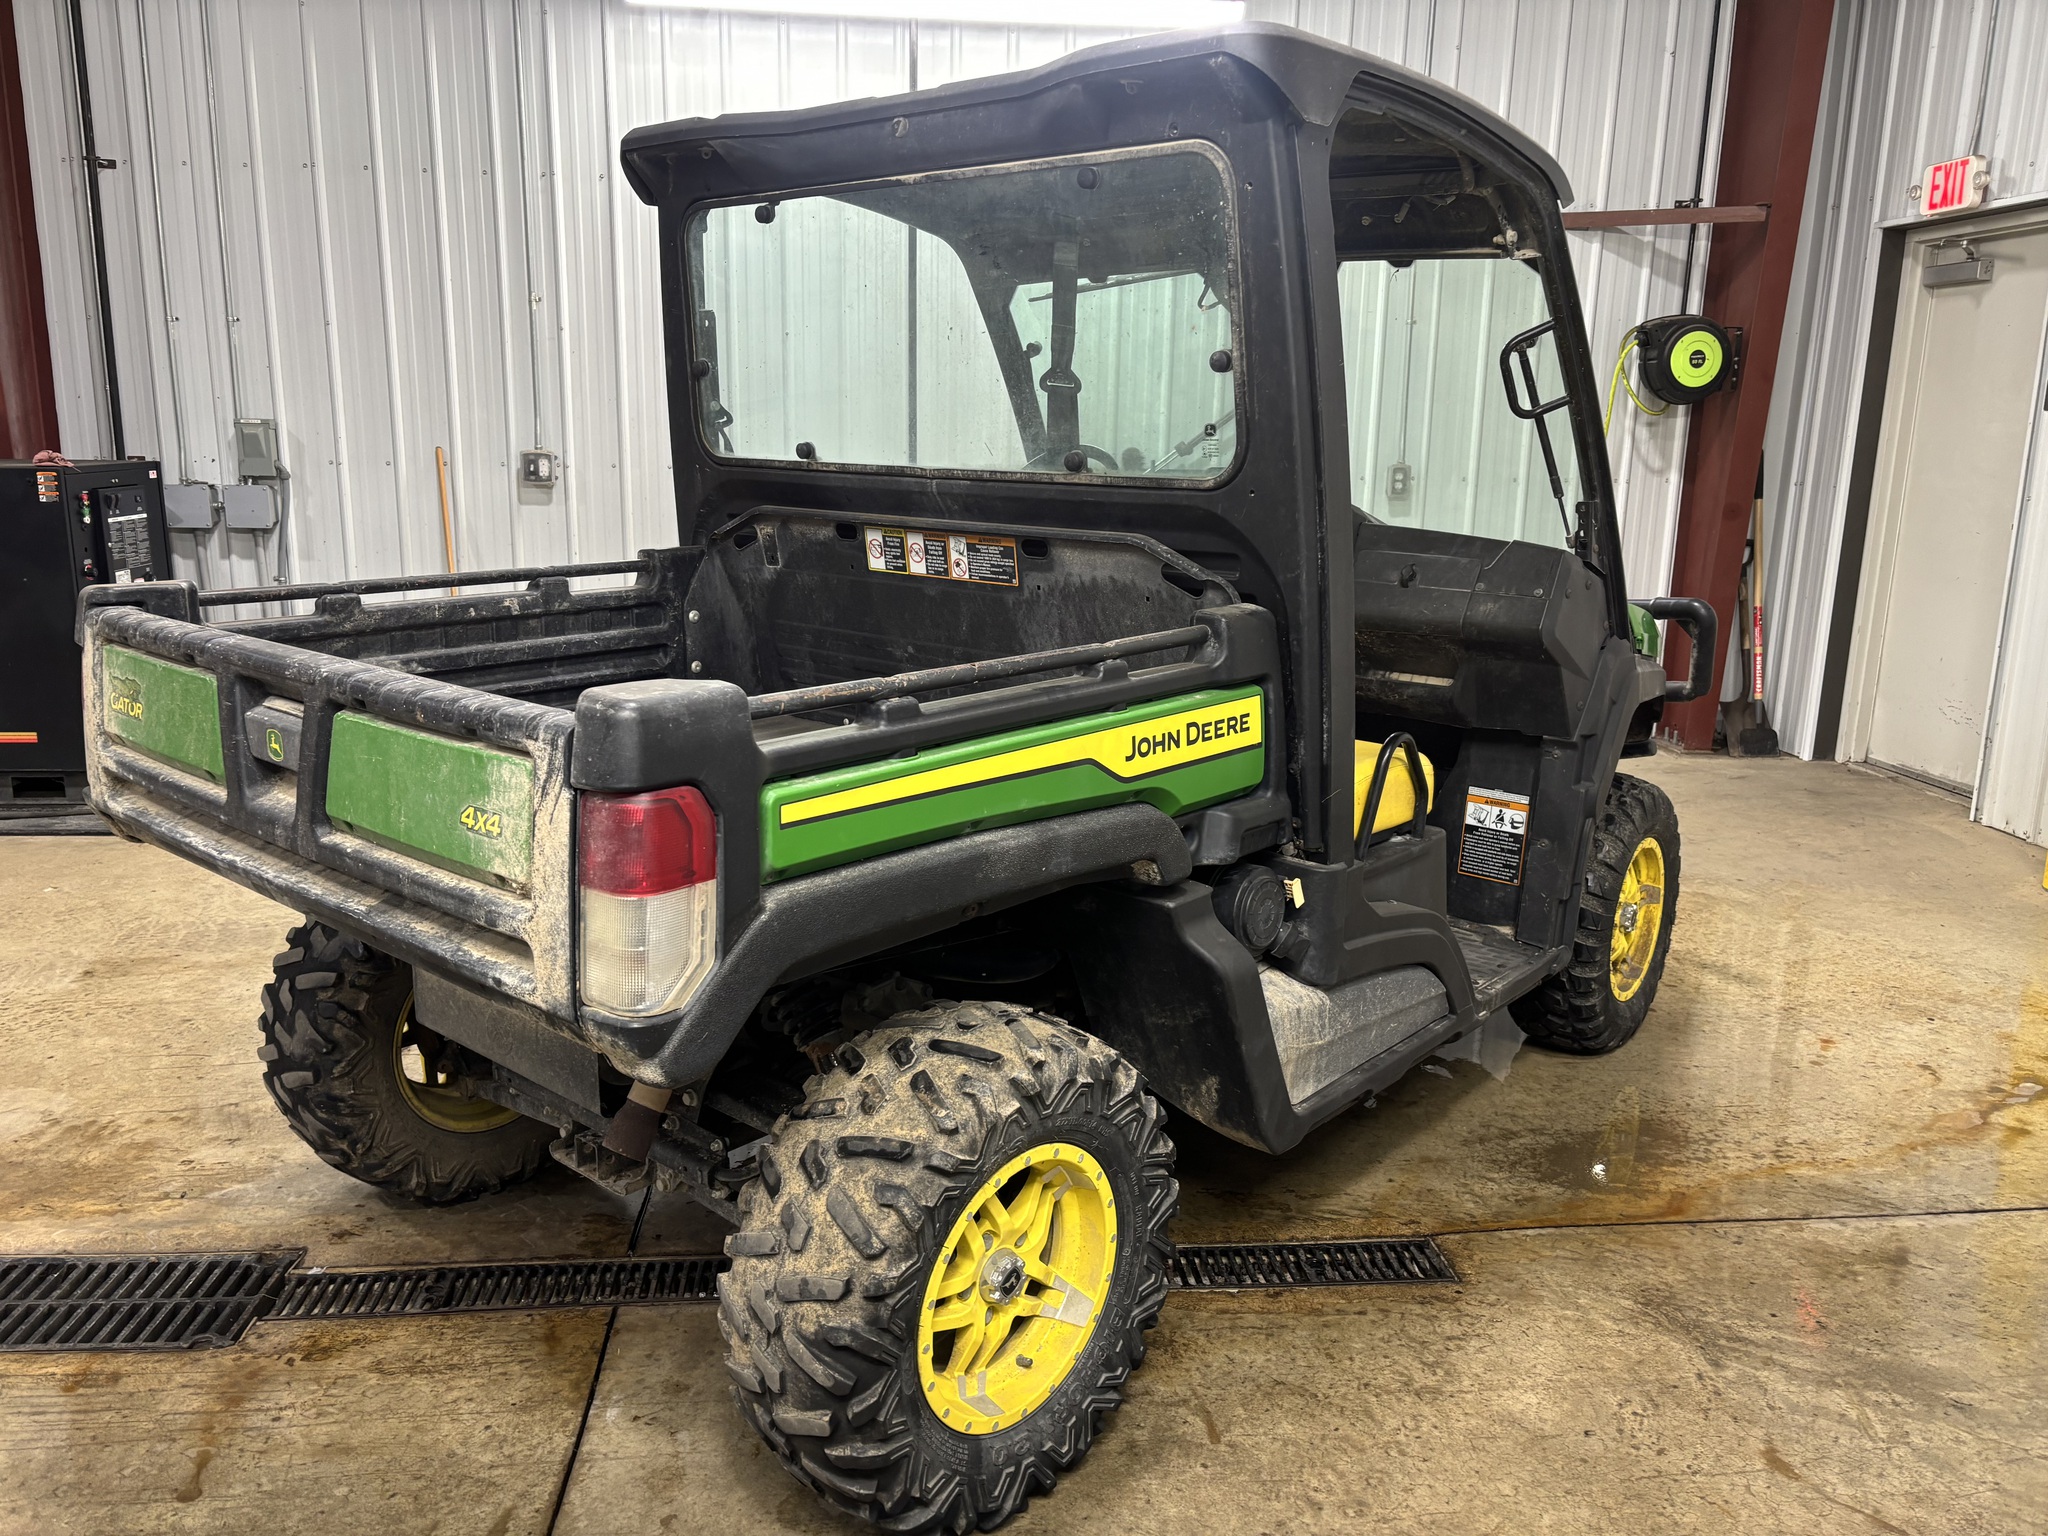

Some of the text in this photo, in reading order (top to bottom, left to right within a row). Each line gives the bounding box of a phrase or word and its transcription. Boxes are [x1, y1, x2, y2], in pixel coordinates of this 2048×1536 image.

[1927, 158, 1970, 210] EXIT
[110, 692, 143, 720] GATOR
[1125, 713, 1250, 762] JOHN DEERE
[1490, 800, 1510, 808] WARNING
